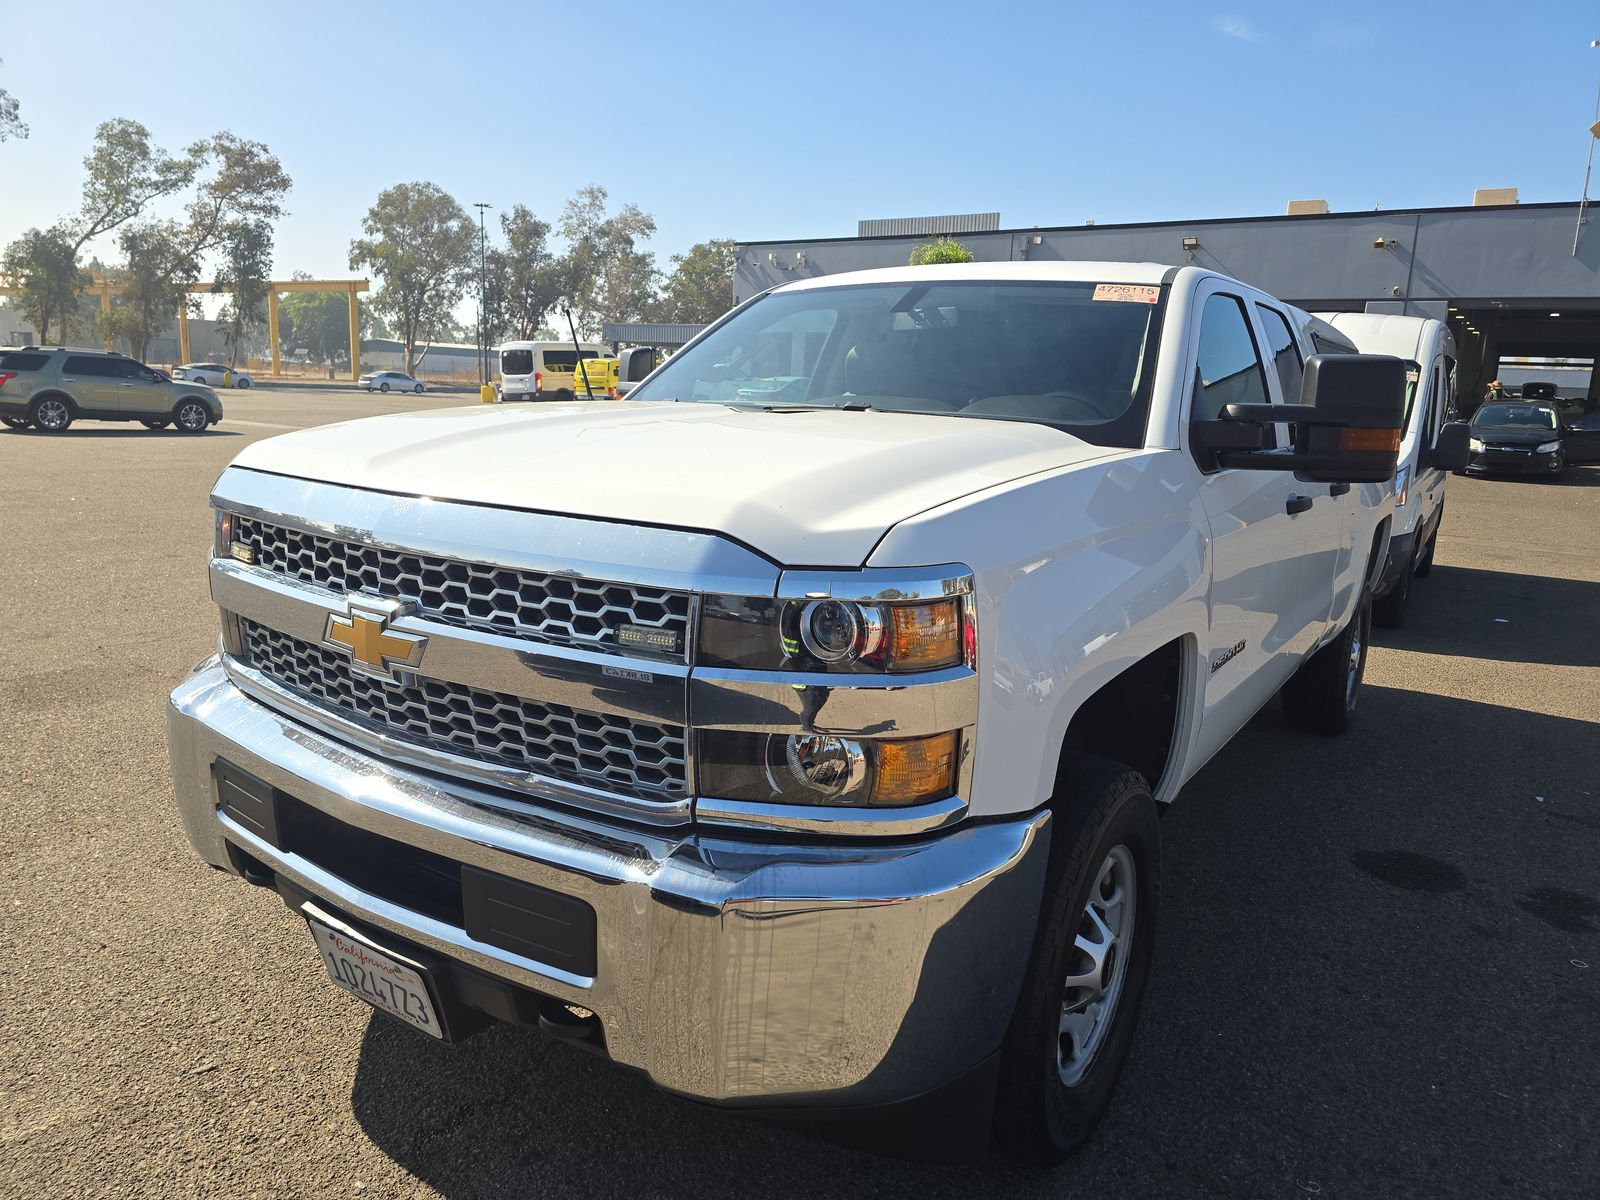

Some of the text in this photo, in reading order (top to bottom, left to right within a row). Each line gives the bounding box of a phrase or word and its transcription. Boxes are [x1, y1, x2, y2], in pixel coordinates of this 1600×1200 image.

[1098, 286, 1155, 295] 4726115
[335, 937, 405, 981] California
[328, 951, 430, 1025] 10247Z3
